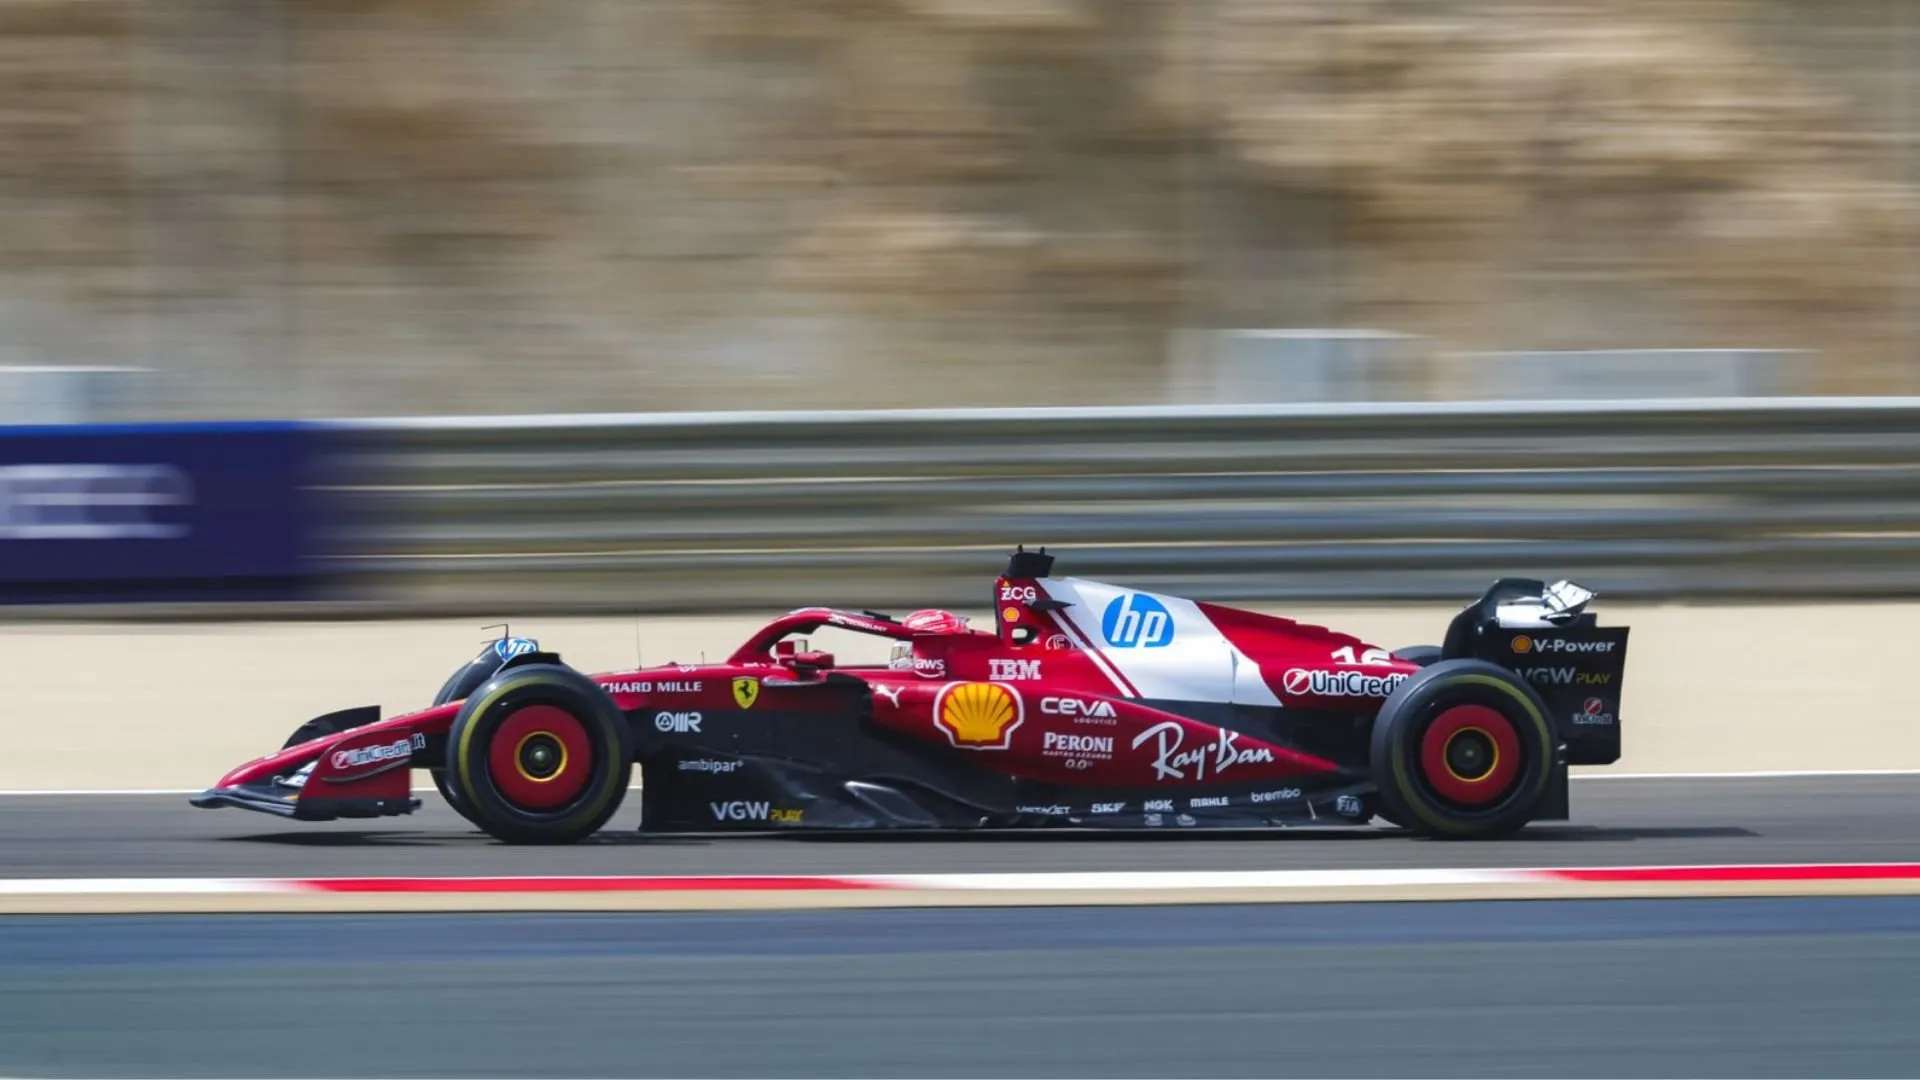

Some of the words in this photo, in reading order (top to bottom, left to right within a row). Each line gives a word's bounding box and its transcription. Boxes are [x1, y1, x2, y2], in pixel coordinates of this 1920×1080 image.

[1001, 586, 1037, 601] ZCG
[1109, 593, 1168, 648] hp
[1533, 639, 1616, 653] V-Power
[914, 658, 945, 670] aws
[988, 659, 1042, 681] IBM
[1515, 667, 1576, 684] VGW
[1576, 672, 1611, 685] PLAY
[657, 681, 703, 692] MILLE
[1043, 731, 1114, 753] PERONI
[1251, 787, 1301, 802] brembo
[1091, 802, 1126, 813] SKF
[1144, 800, 1174, 811] NGK
[1190, 796, 1229, 808] MAHLE
[1336, 799, 1360, 813] FIA
[710, 801, 770, 820] VGW
